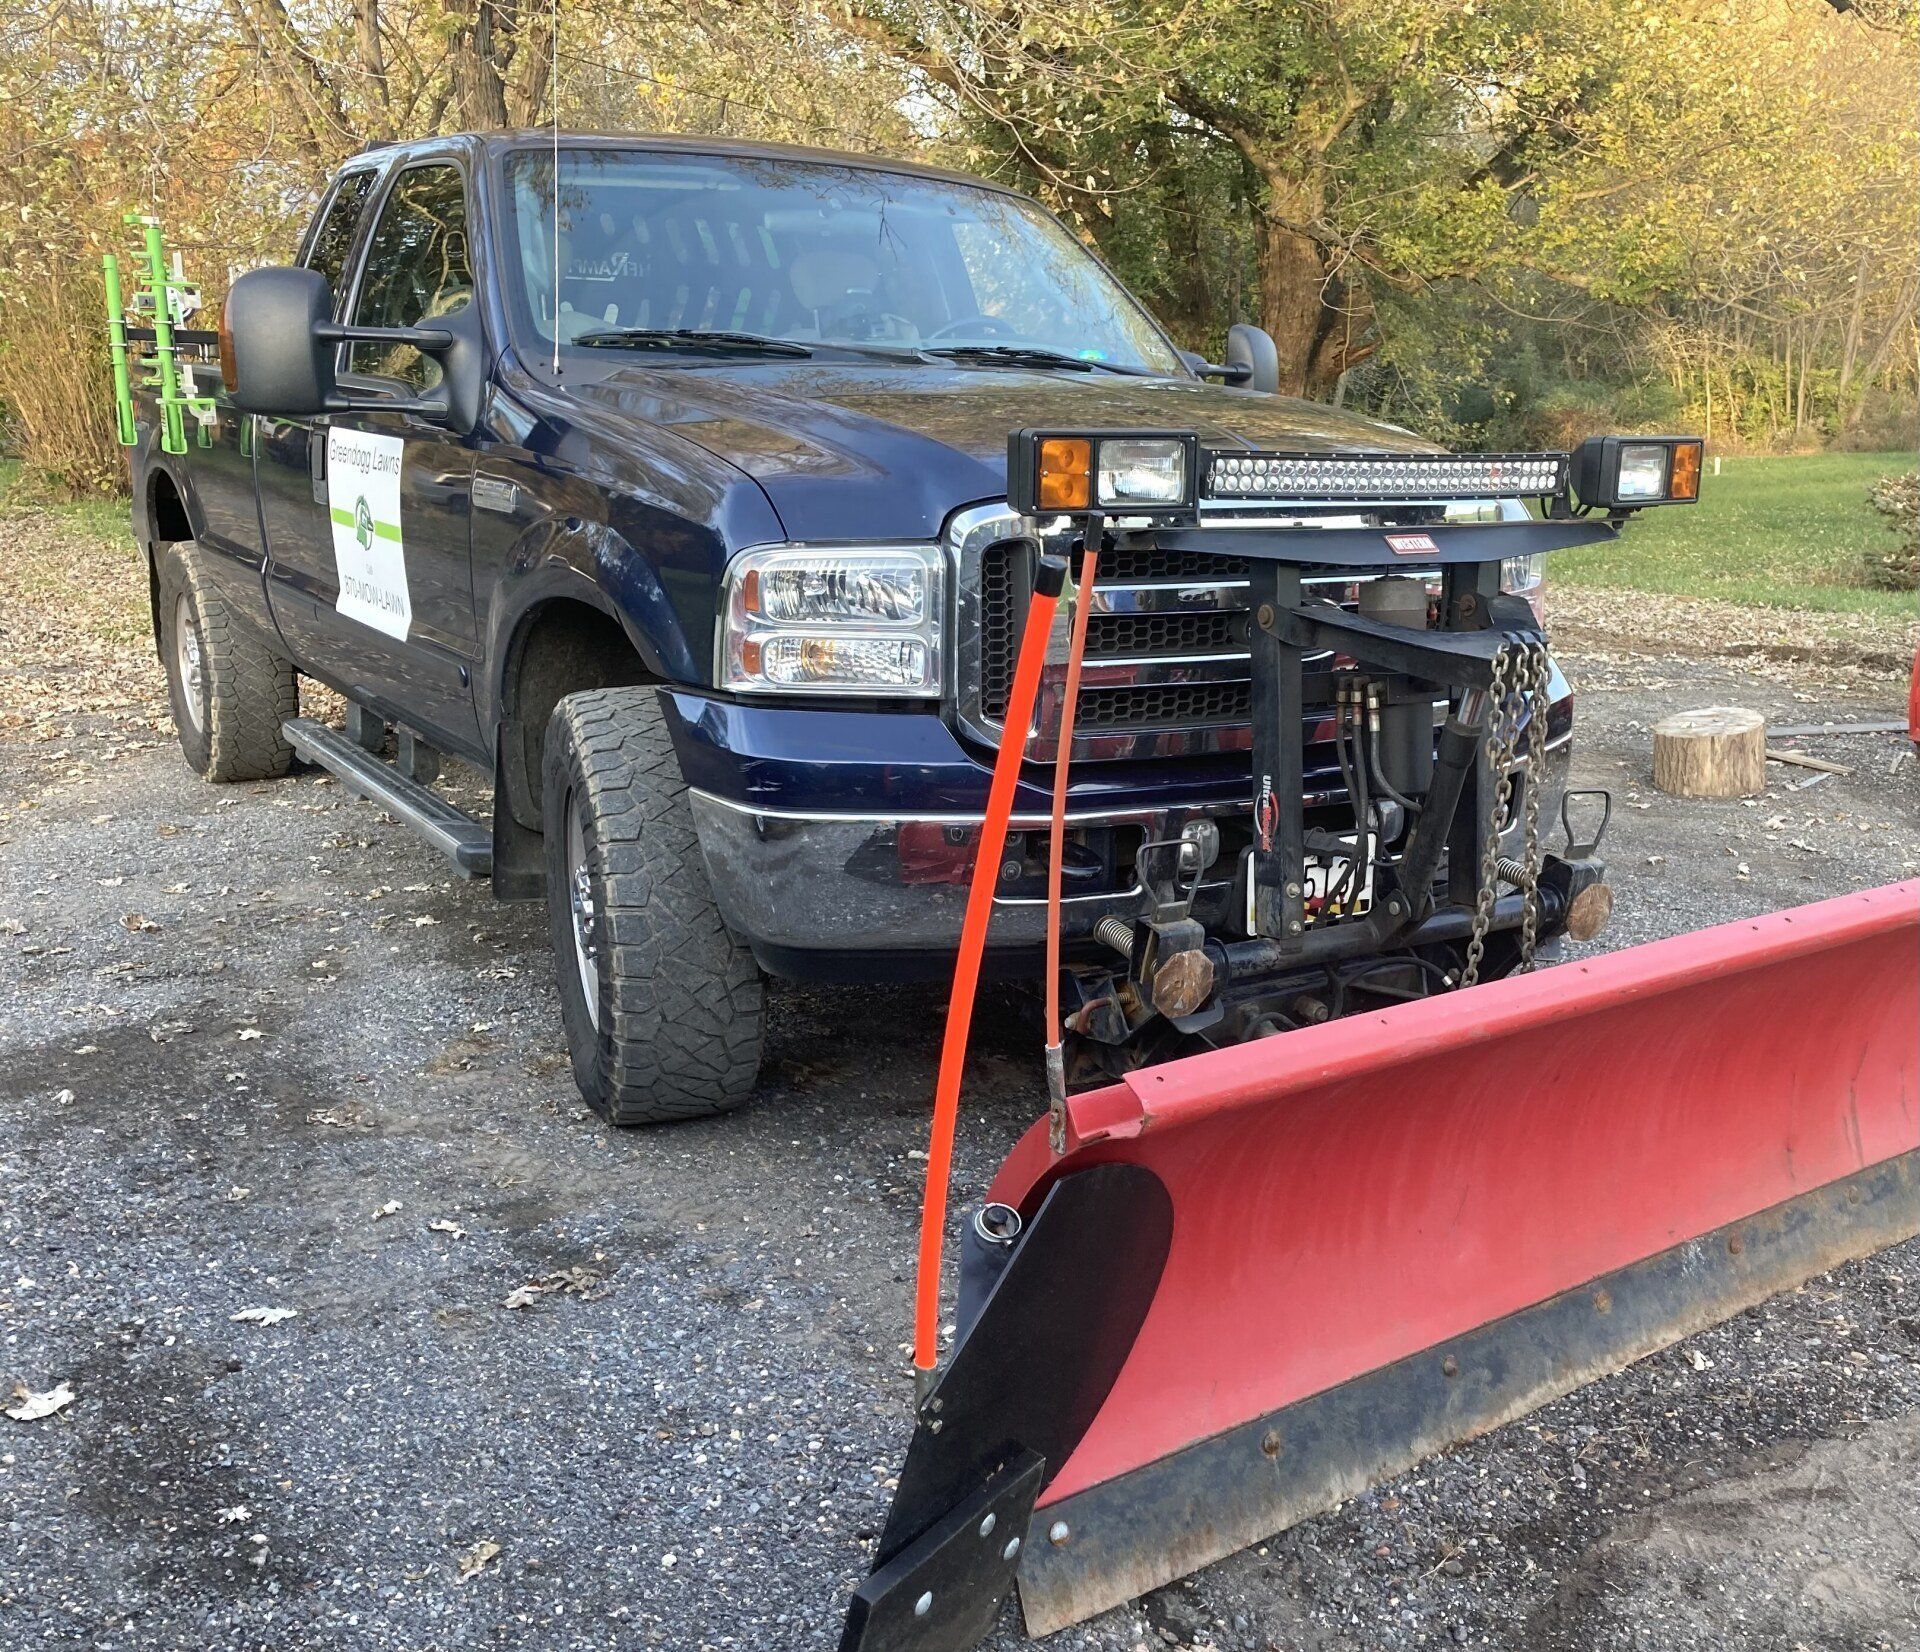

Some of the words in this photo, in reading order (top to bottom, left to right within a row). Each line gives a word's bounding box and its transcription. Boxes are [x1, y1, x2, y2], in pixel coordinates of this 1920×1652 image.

[330, 438, 371, 475] Greendogg
[372, 446, 400, 475] Lawns
[1388, 537, 1436, 550] WESTERN
